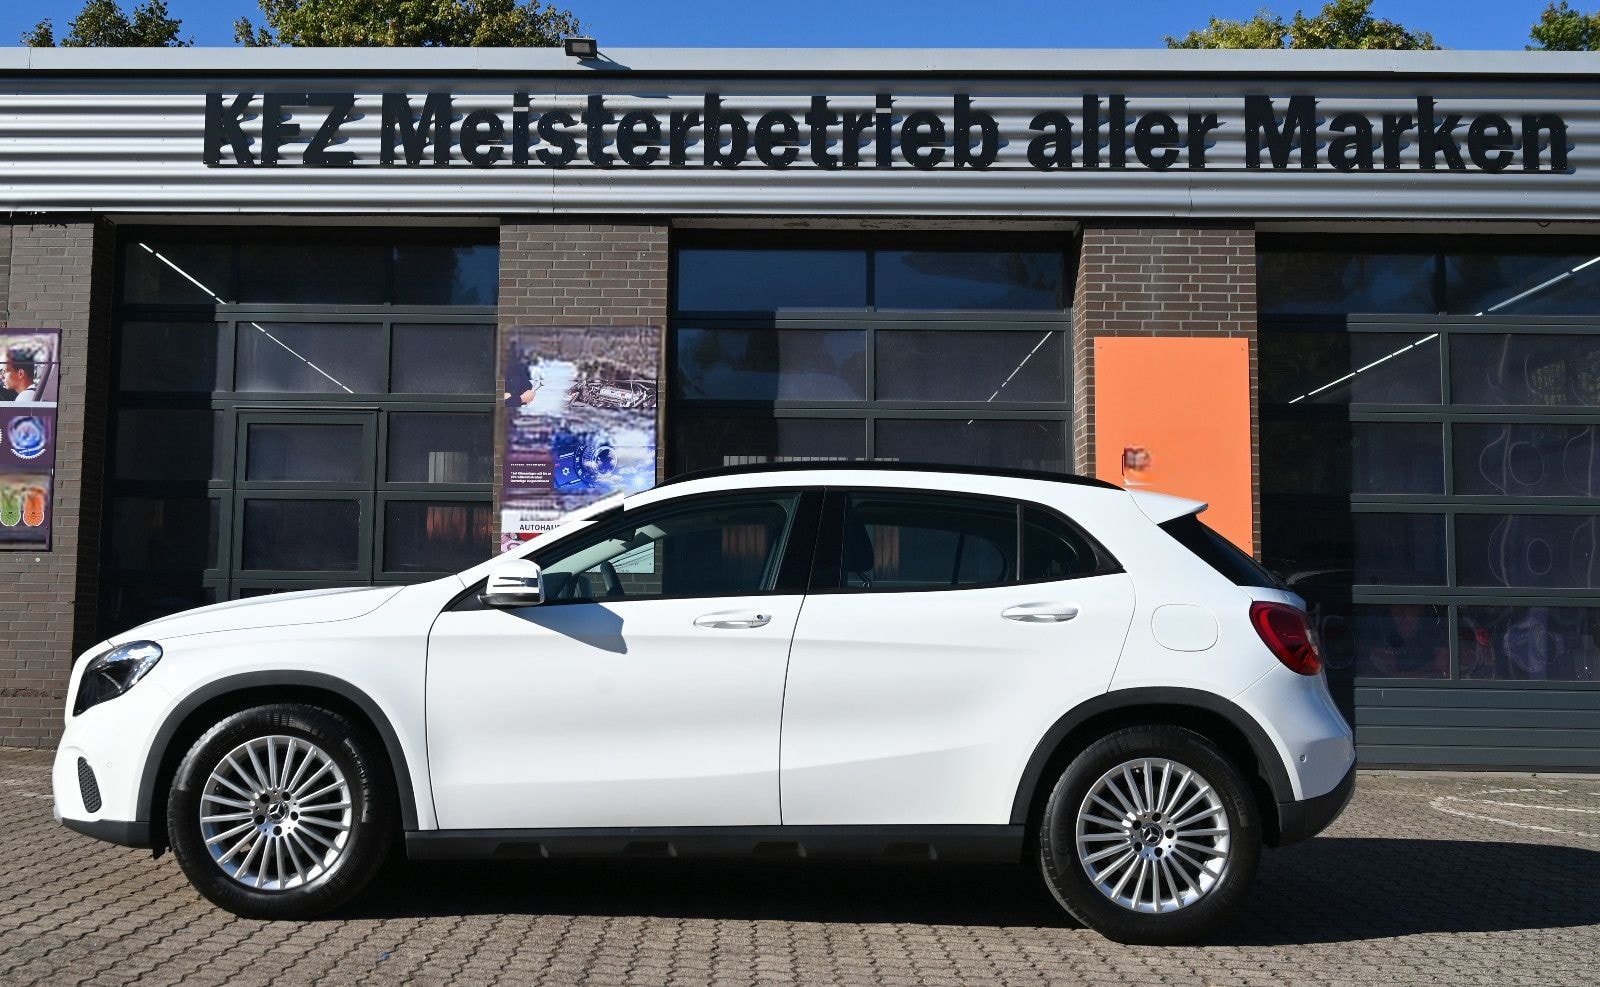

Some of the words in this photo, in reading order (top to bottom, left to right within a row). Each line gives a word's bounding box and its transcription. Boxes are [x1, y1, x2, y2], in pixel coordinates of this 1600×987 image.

[203, 92, 355, 165] KFZ
[379, 92, 1000, 169] Meisterbetrieb
[1027, 93, 1219, 170] aller
[1244, 94, 1569, 173] Marken
